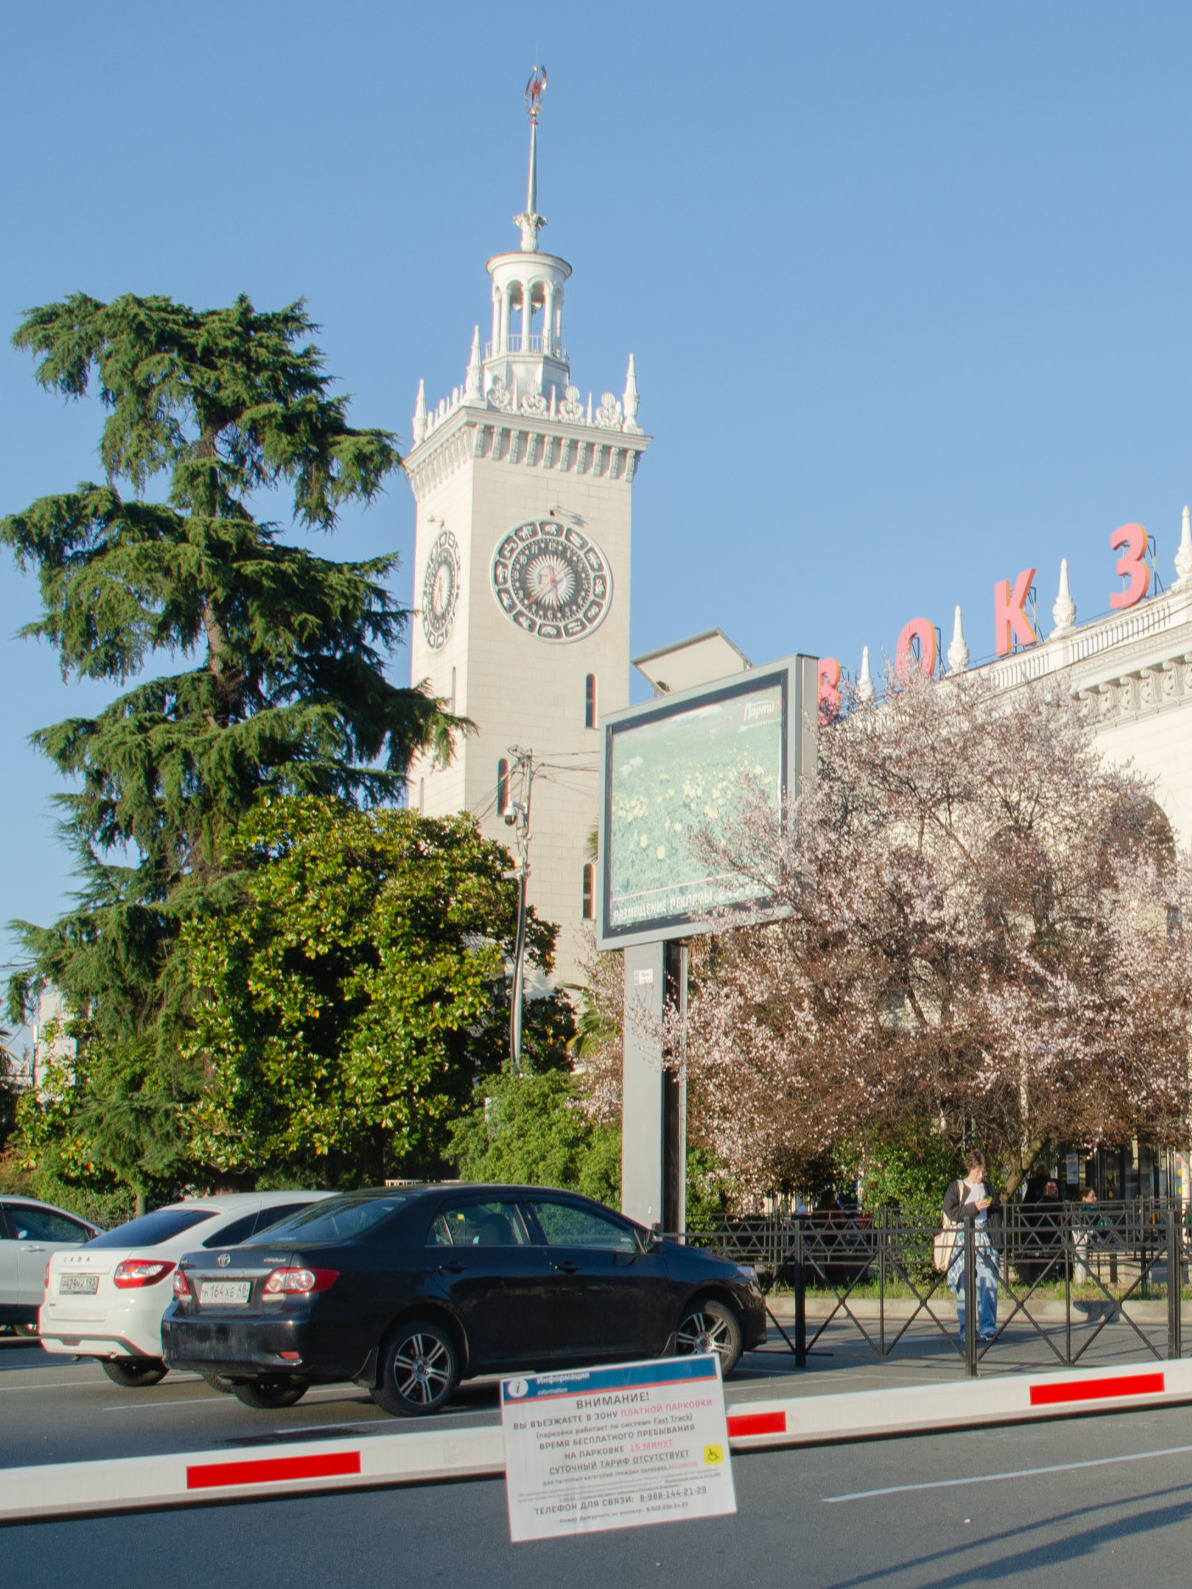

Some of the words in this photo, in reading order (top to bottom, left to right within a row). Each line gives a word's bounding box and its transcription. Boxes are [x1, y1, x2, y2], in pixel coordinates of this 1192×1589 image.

[536, 1372, 589, 1384] Информация
[576, 1391, 649, 1409] ВНИМАНИЕ!
[513, 1421, 526, 1430] ВЫ
[530, 1414, 583, 1428] ВЪЕЗЖАЕТЕ
[586, 1413, 592, 1421] В
[594, 1410, 617, 1420] ЗОНУ
[620, 1403, 662, 1417] ПЛАТНОЙ
[665, 1398, 712, 1411] ПАРКОВКИ
[575, 1423, 607, 1435] работает
[653, 1416, 668, 1424] Fast
[539, 1439, 569, 1450] ВРЕМЯ
[573, 1431, 634, 1445] БЕСПЛАТНОГО
[636, 1423, 695, 1437] ПРЕБЫВАНИЯ
[564, 1451, 576, 1459] НА
[579, 1445, 624, 1457] ПАРКОВКЕ
[642, 1438, 673, 1450] МИНУТ
[549, 1460, 597, 1474] СУТОЧНЫЙ
[600, 1457, 629, 1468] ТАРИФ
[632, 1449, 689, 1464] ОТСУТСТВУЕТ
[534, 1502, 577, 1515] ТЕЛЕФОН
[579, 1499, 599, 1510] ДЛЯ
[602, 1494, 634, 1506] СВЯЗИ:
